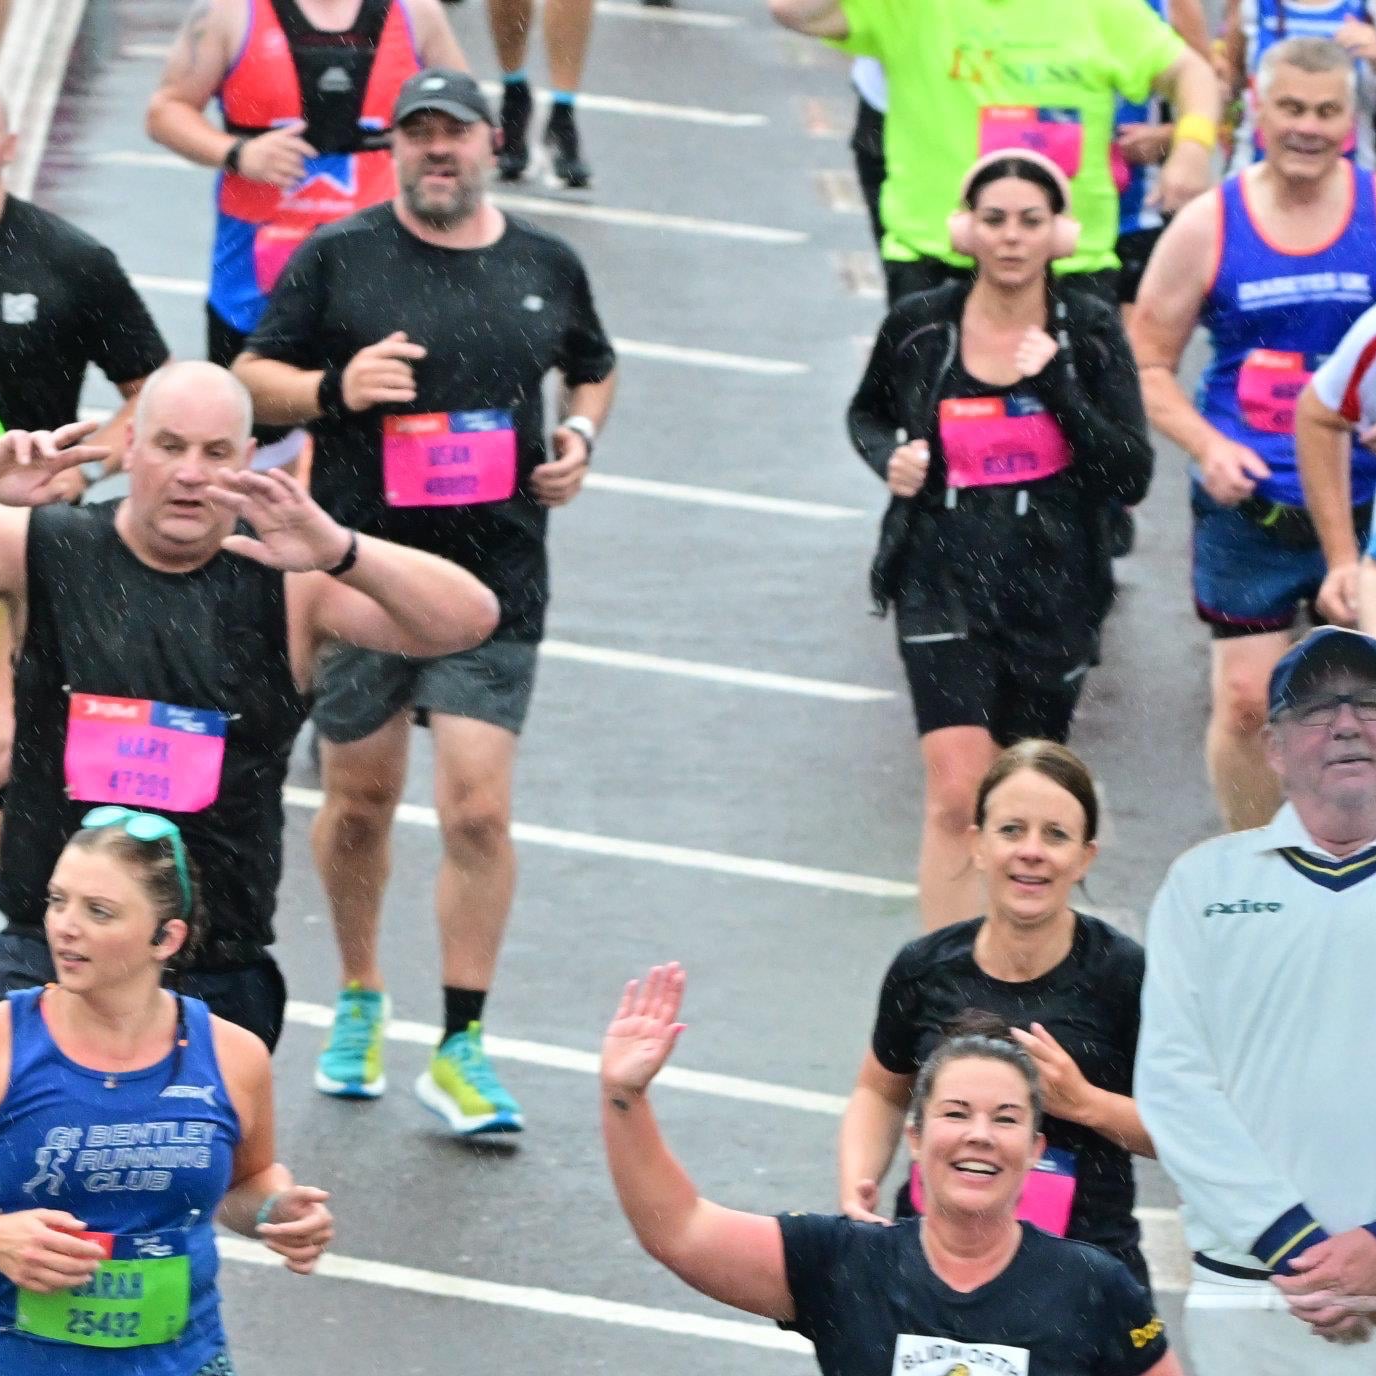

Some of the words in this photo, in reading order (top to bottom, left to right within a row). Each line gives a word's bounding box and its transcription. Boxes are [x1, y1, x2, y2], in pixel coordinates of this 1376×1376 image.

[85, 1120, 218, 1148] BENTLEY
[75, 1146, 212, 1173] RUNNING
[84, 1171, 173, 1194] CLUB
